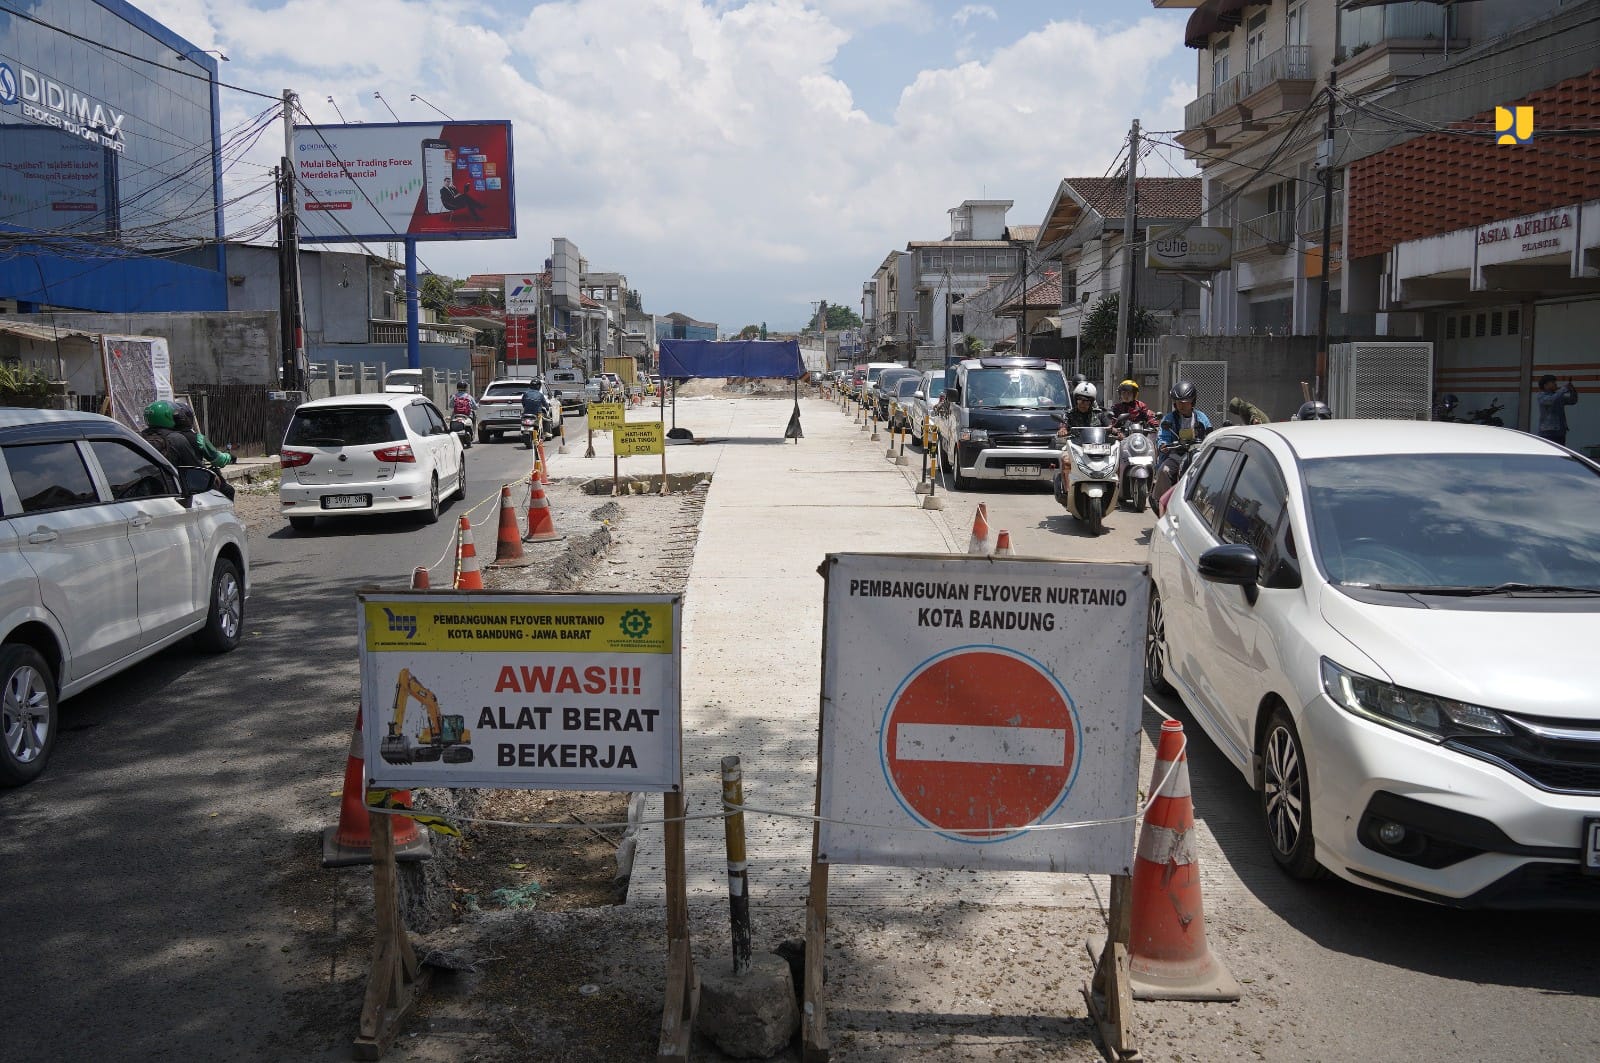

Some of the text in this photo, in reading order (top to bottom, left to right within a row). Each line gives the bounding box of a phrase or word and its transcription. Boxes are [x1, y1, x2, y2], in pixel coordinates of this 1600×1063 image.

[20, 69, 126, 140] DIDIMAX
[22, 103, 126, 153] BROKER YOU CAN TRUST
[300, 158, 413, 169] Mulai Belajar Trading Forex
[301, 170, 377, 179] Merdeka Financial
[1478, 213, 1571, 246] ASIA AFRIKA
[1522, 238, 1561, 252] PLASTIK
[850, 579, 1127, 607] PEMBANGUNAN FLYOVER NURTANIO
[433, 615, 605, 626] PEMBANGUNAN FLYOVER NURTANIO
[918, 608, 1055, 632] KOTA BANDUNG
[448, 629, 474, 639] KOTA
[476, 629, 523, 640] BANDUNG
[531, 630, 557, 639] JAWA
[560, 630, 592, 640] BARAT
[494, 665, 641, 695] AWAS!!!
[476, 706, 660, 732] ALAT BERAT
[497, 743, 638, 769] BEKERJA
